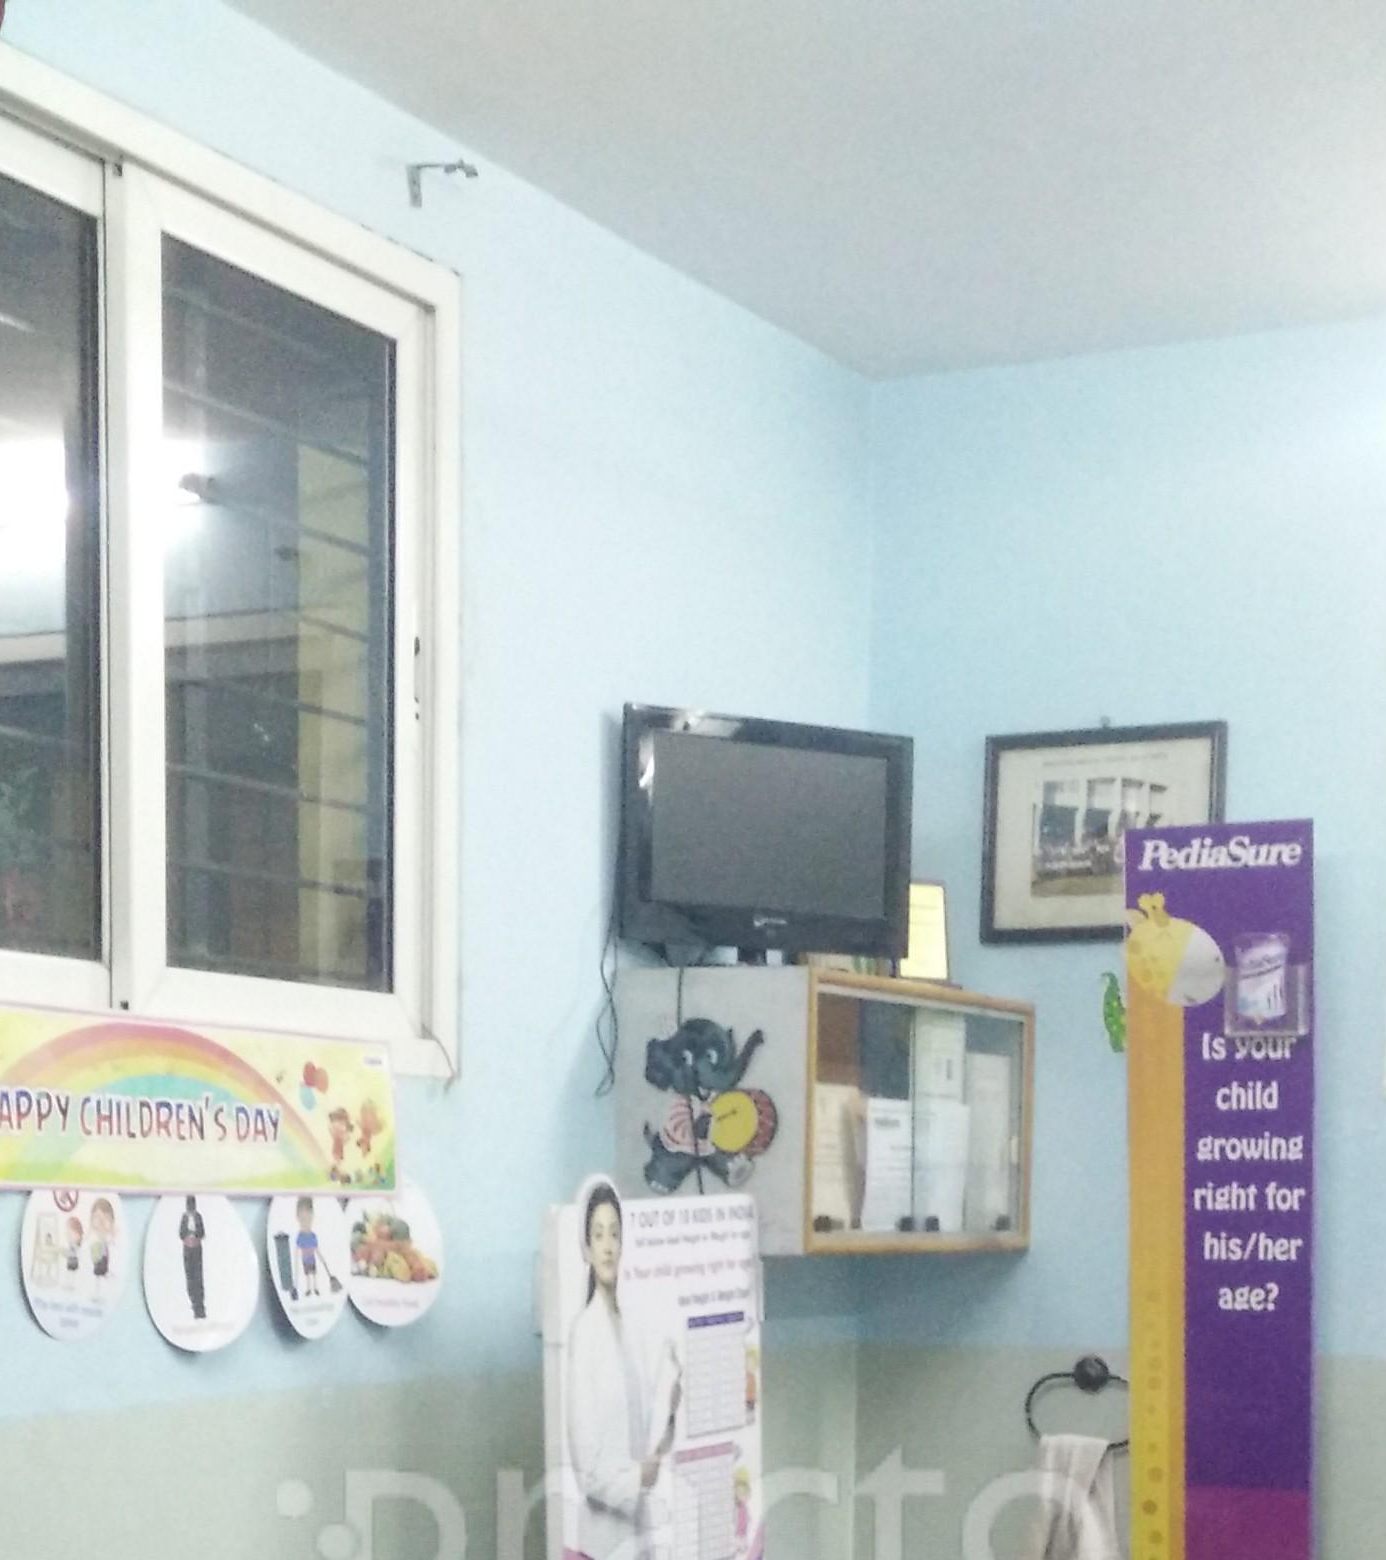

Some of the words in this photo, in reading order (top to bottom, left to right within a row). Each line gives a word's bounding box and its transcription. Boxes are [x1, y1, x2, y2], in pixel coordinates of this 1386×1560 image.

[1137, 835, 1303, 871] PediaSure
[1201, 1032, 1227, 1060] Is
[1235, 1037, 1297, 1060] your
[1216, 1081, 1278, 1110] child
[80, 1095, 228, 1142] CHILDREN'S
[235, 1105, 281, 1143] DAY
[1196, 1132, 1304, 1161] growing
[1193, 1182, 1257, 1211] right
[1265, 1182, 1306, 1211] for
[1203, 1231, 1304, 1261] his/her
[1217, 1282, 1279, 1311] age?
